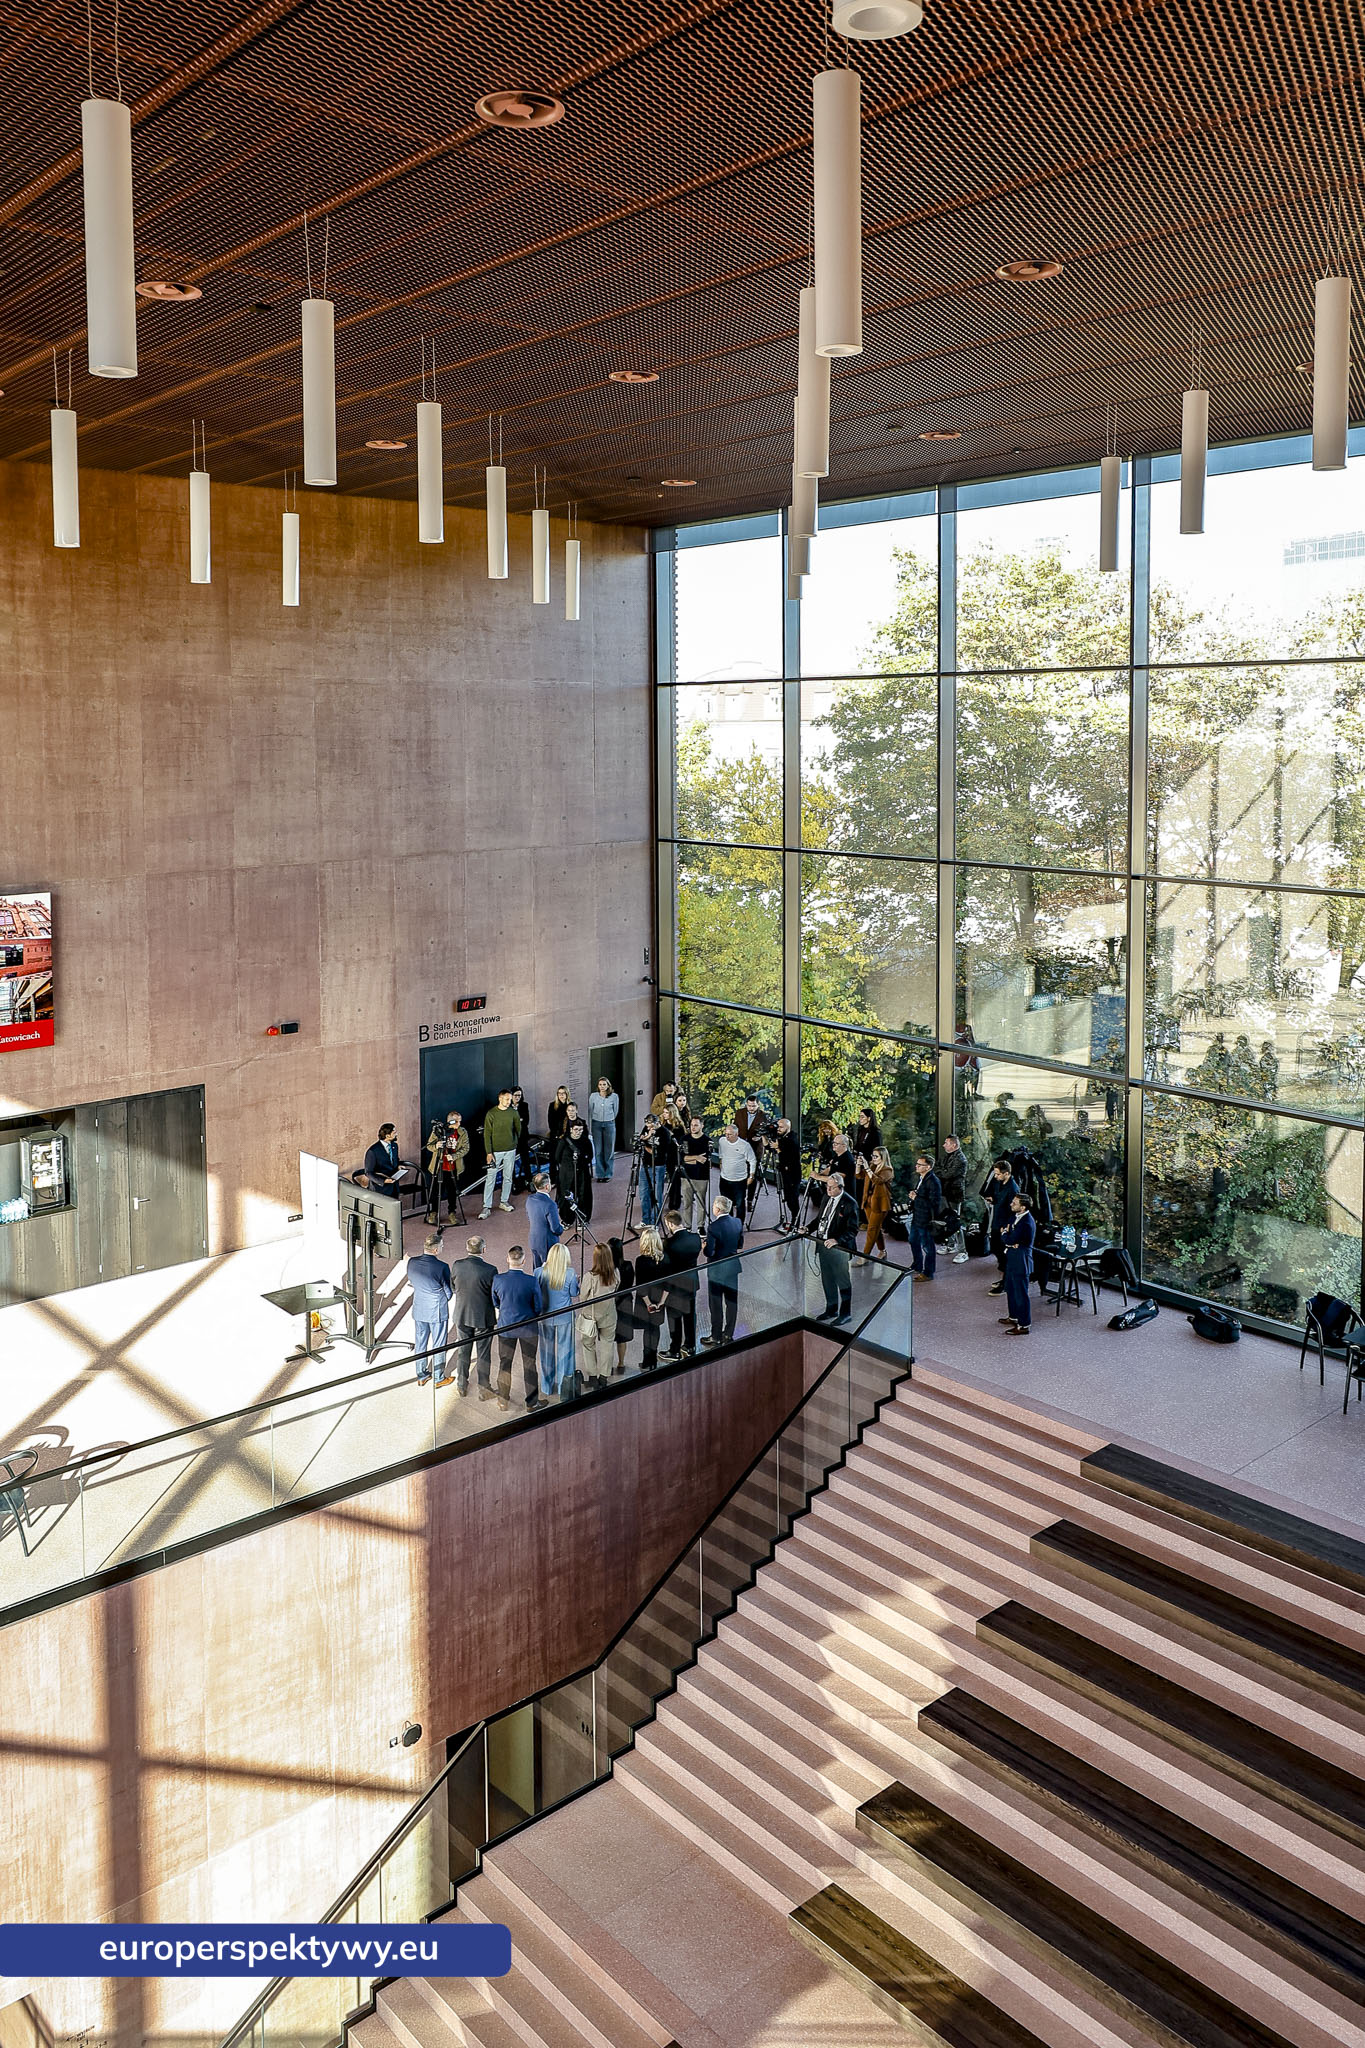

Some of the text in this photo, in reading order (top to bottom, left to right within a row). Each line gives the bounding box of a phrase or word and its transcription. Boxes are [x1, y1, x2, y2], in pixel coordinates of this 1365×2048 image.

[433, 1015, 501, 1032] Sala Koncertowa
[419, 1025, 430, 1042] B
[433, 1025, 482, 1041] Concert Hall
